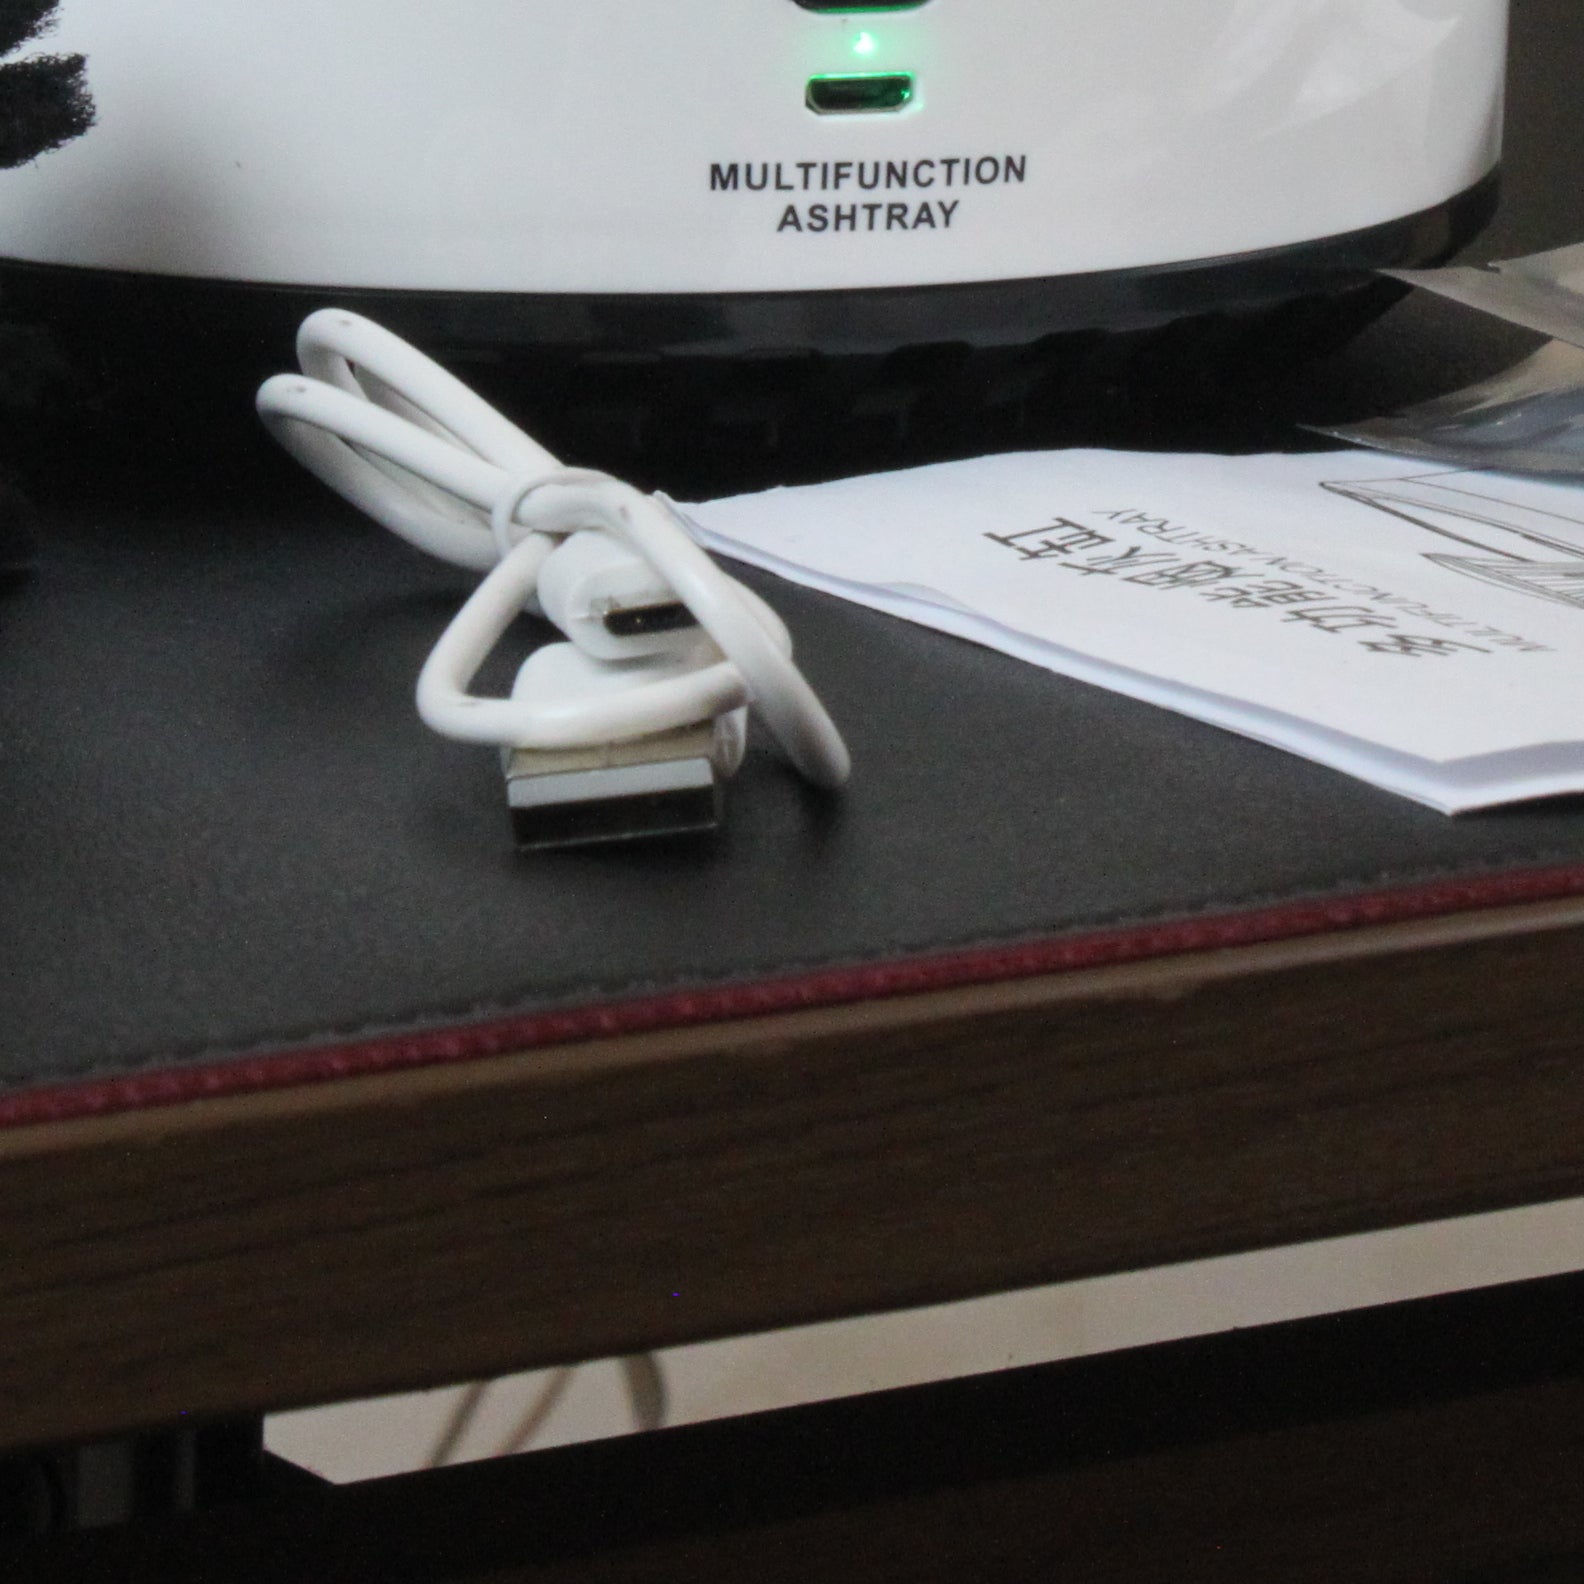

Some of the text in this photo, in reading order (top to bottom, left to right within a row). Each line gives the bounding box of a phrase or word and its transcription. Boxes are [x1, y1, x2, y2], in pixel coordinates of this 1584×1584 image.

[710, 155, 1027, 191] MULTIFUNCTION
[777, 200, 959, 233] ASHTRAY
[982, 516, 1493, 656] 多功能烟灰缸
